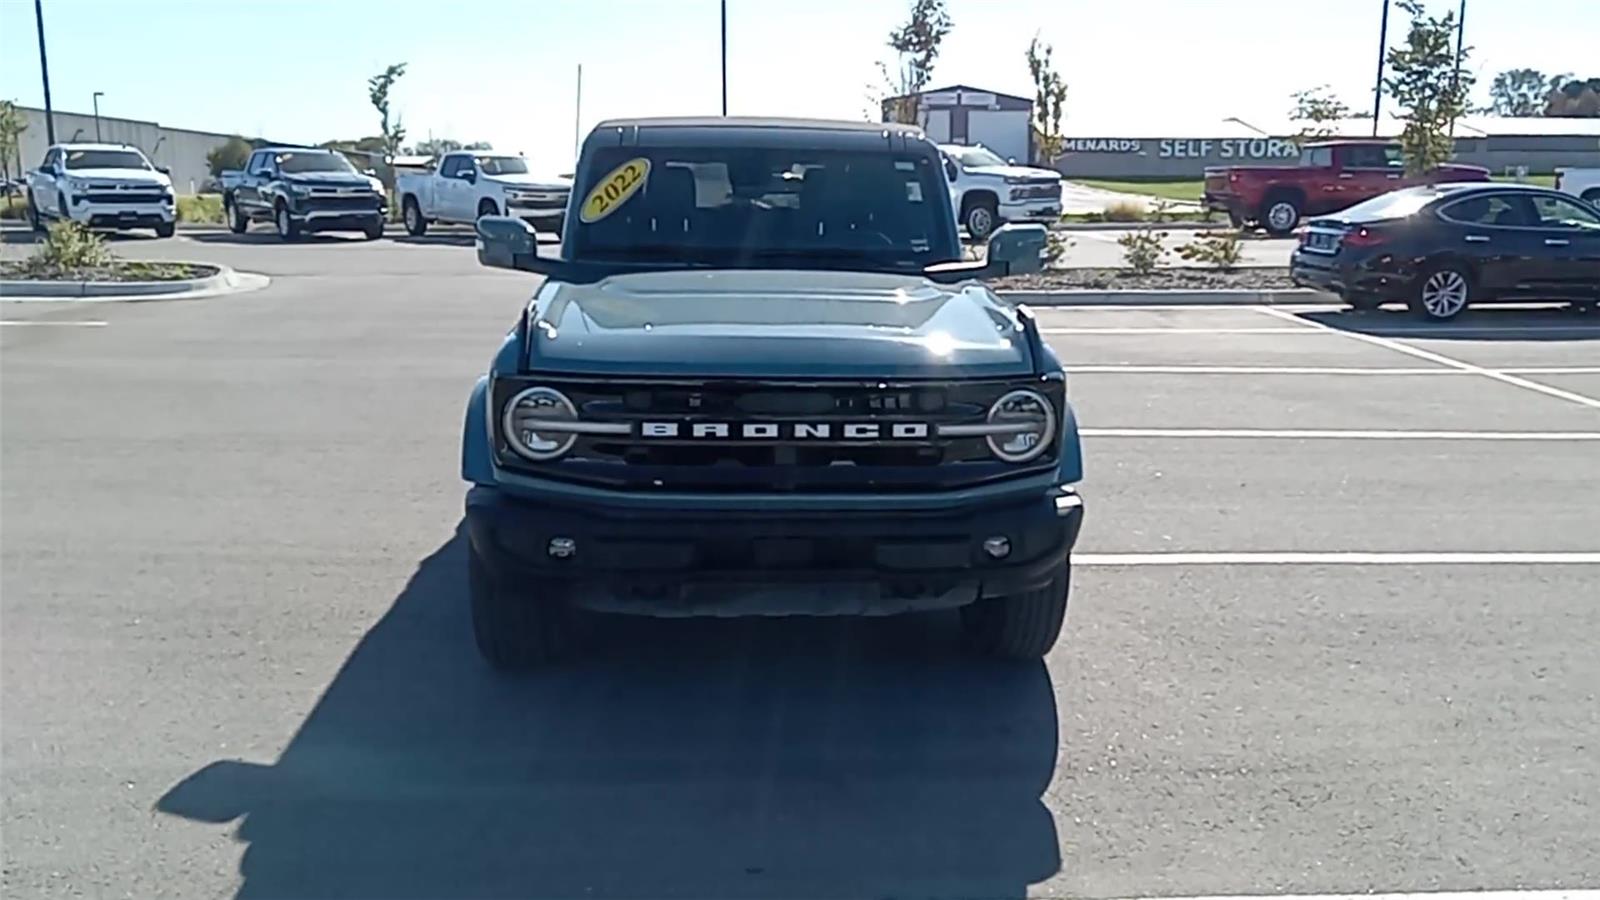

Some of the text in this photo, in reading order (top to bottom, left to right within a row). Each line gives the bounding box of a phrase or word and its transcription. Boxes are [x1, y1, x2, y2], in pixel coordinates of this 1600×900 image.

[1062, 138, 1300, 158] MENARDS SELF STORA
[592, 165, 642, 213] 2022
[642, 422, 928, 438] BRONCO
